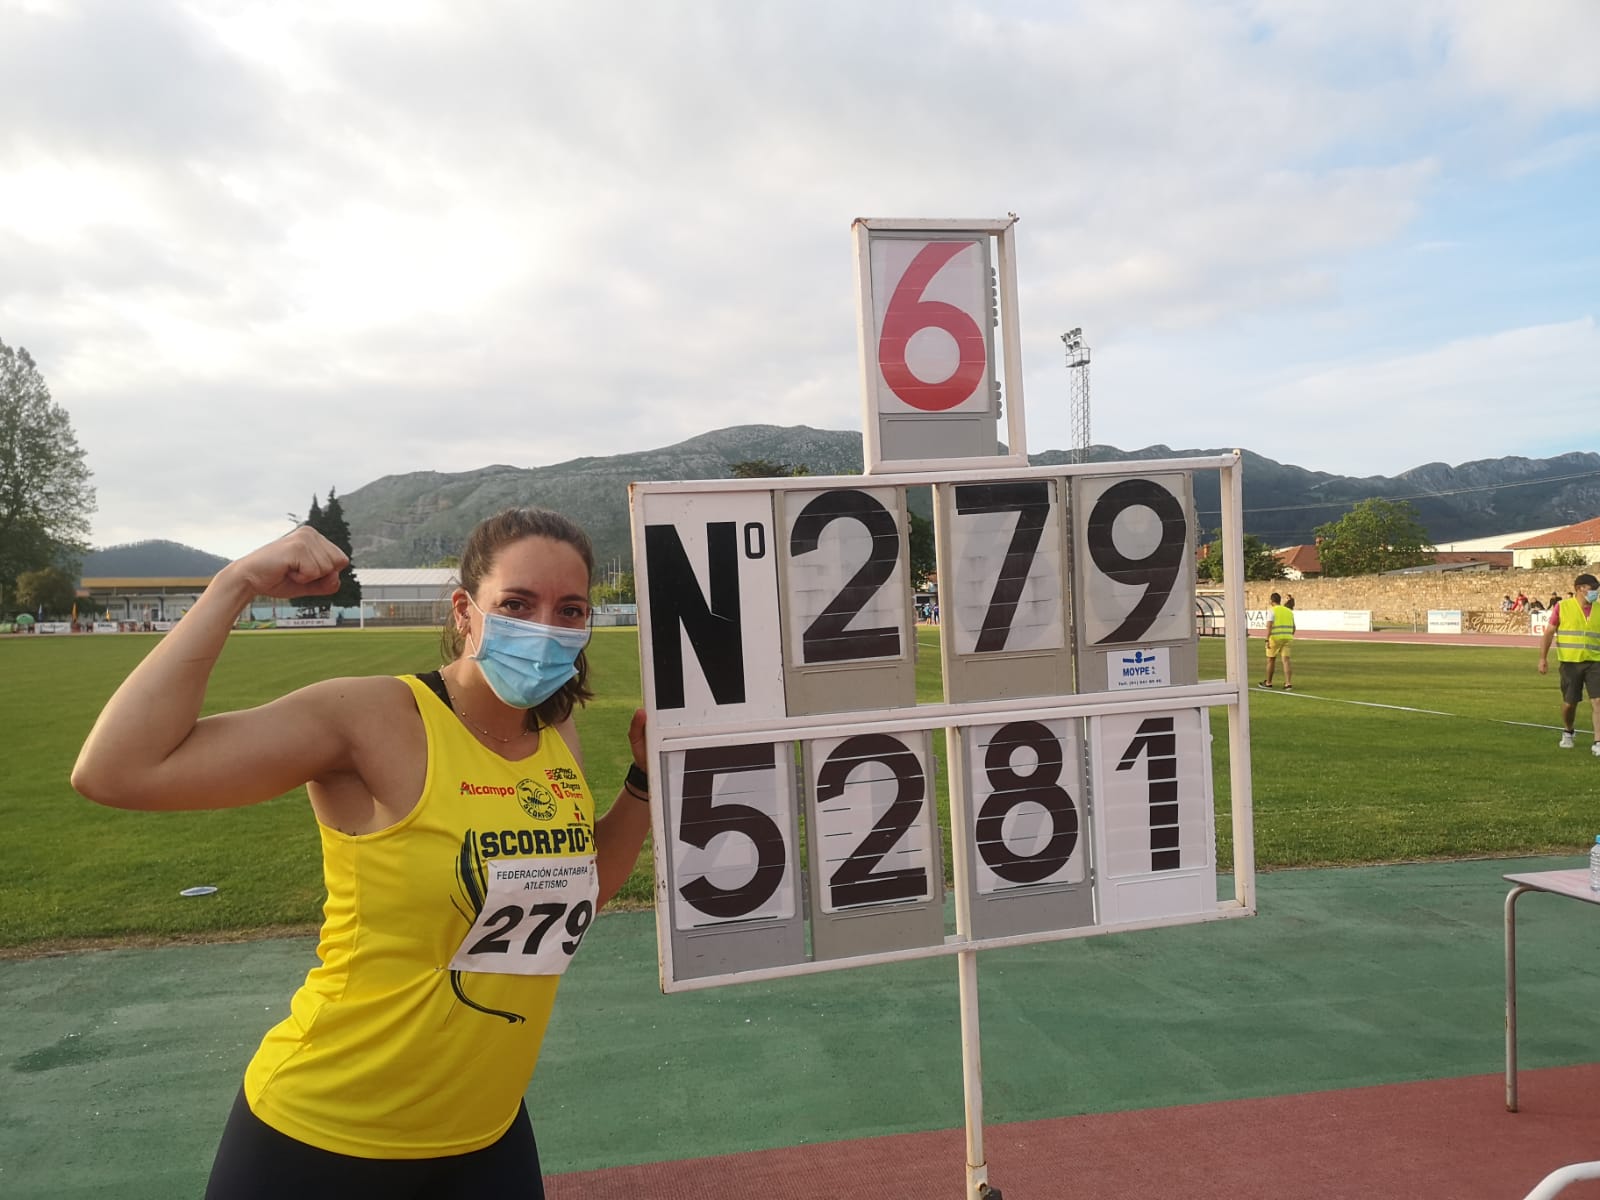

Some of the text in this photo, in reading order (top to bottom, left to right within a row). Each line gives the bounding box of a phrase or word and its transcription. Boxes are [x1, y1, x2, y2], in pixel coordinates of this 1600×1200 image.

[878, 241, 986, 412] 6
[1122, 666, 1150, 677] MOYPE
[460, 781, 516, 797] Alcampo
[496, 866, 588, 880] FEDERACIÓN CÁNTABRA
[523, 879, 568, 890] ATLETISMO
[467, 900, 593, 955] 279
